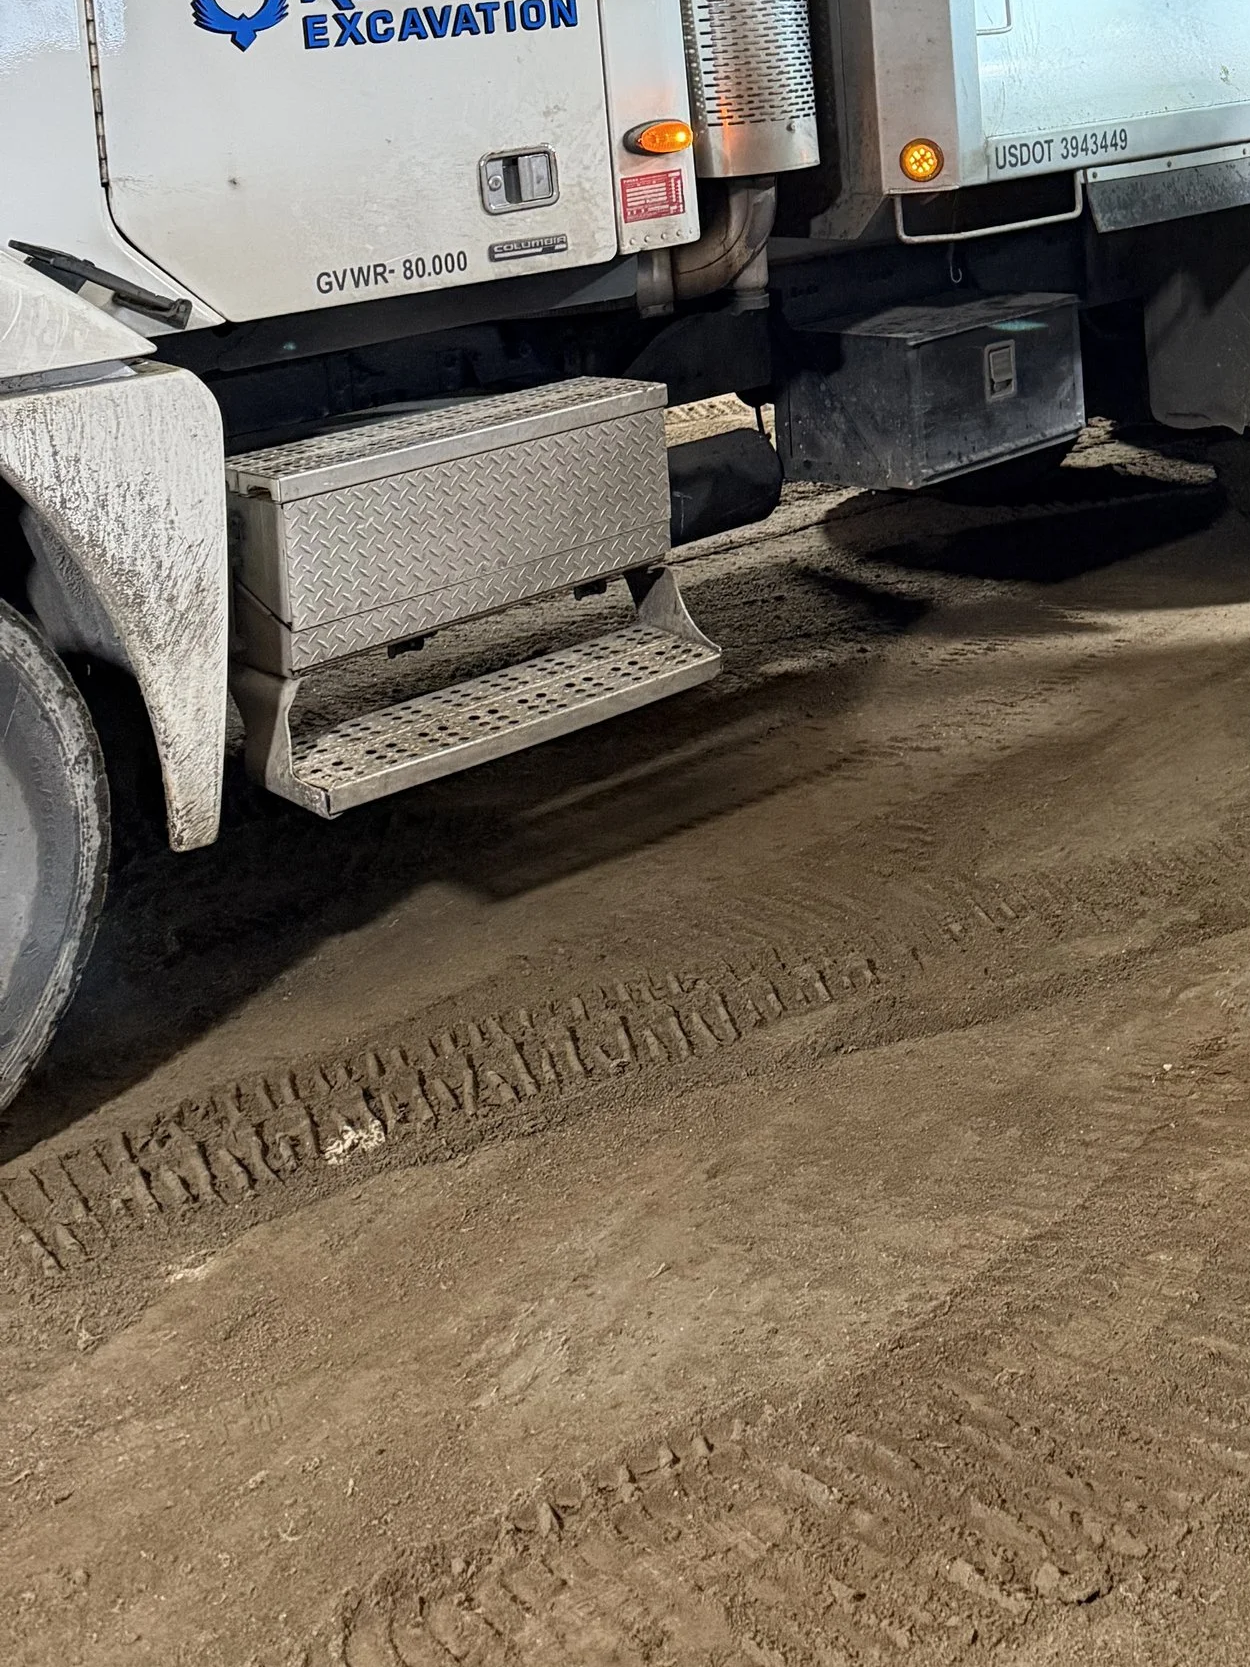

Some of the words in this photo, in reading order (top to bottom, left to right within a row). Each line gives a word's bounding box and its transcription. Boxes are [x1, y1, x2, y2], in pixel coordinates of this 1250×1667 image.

[995, 138, 1054, 170] USDOT
[1060, 128, 1128, 160] 3943449
[493, 235, 567, 253] COLUMBIA
[316, 262, 395, 294] GVWR-
[402, 250, 468, 280] 80.000
